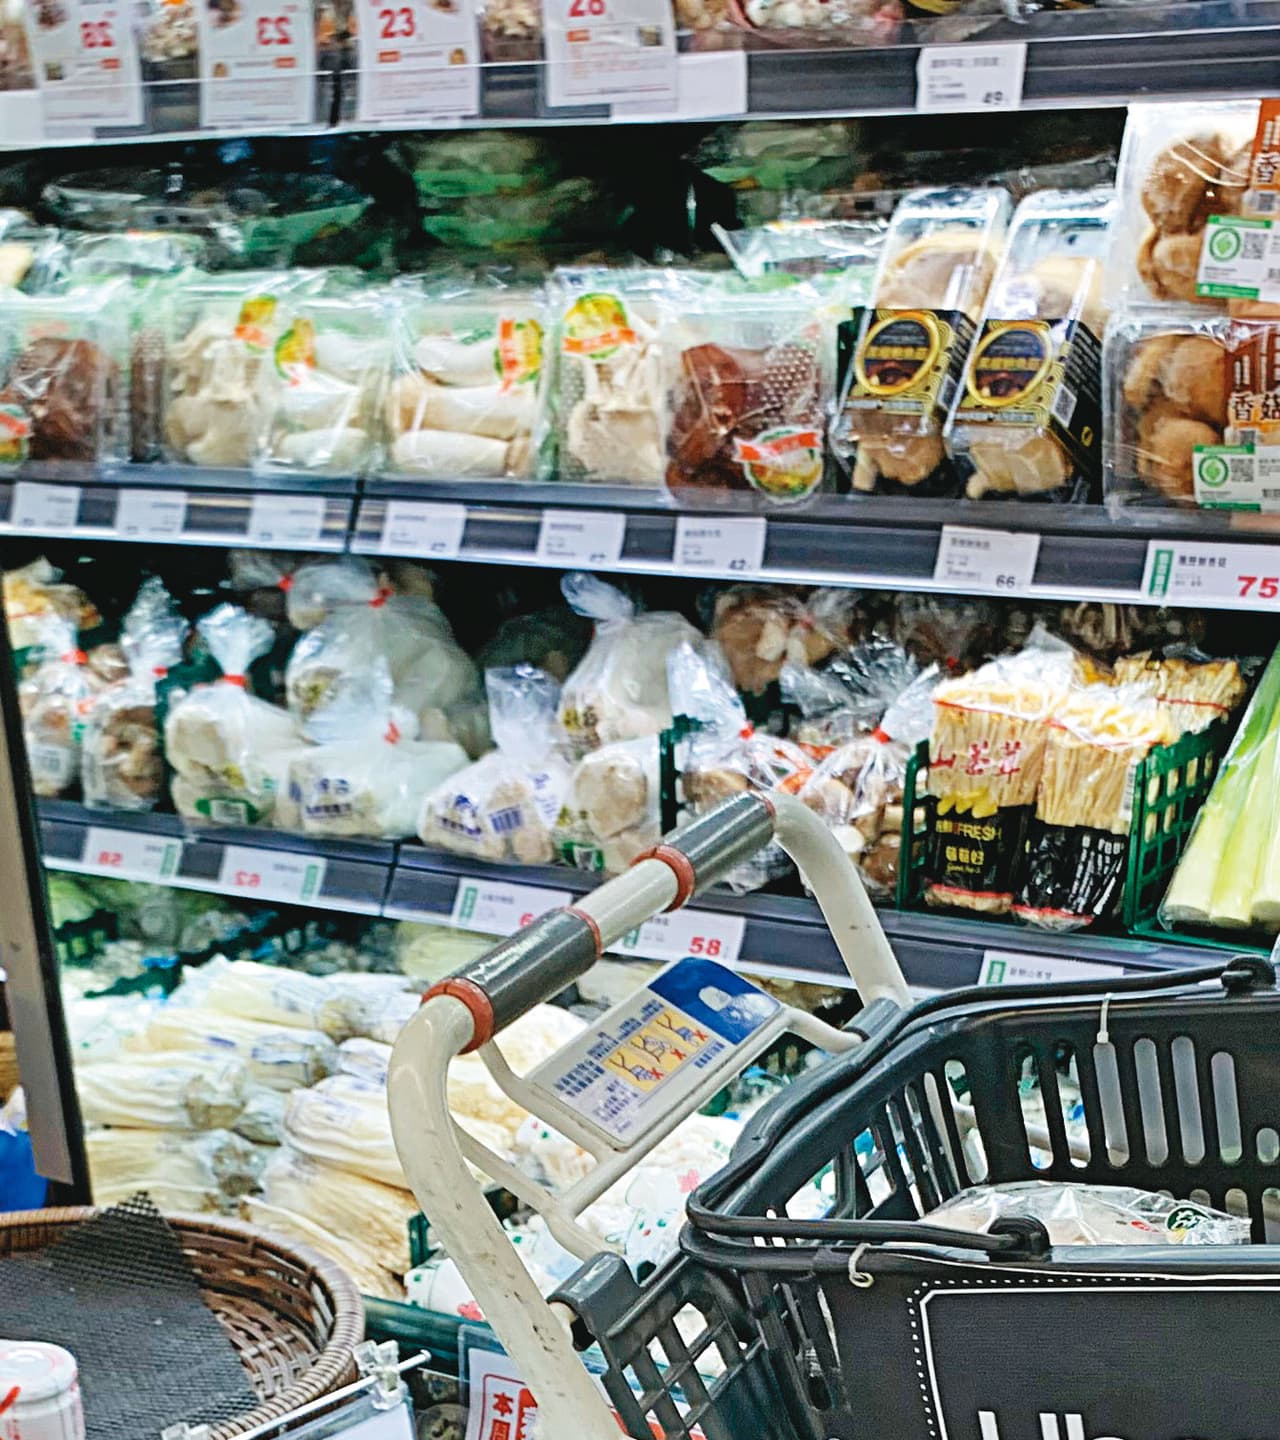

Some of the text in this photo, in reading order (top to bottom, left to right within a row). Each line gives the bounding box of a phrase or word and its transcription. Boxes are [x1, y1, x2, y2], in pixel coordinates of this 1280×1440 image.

[379, 7, 416, 39] 23
[1237, 575, 1279, 599] 75
[689, 936, 722, 956] 58
